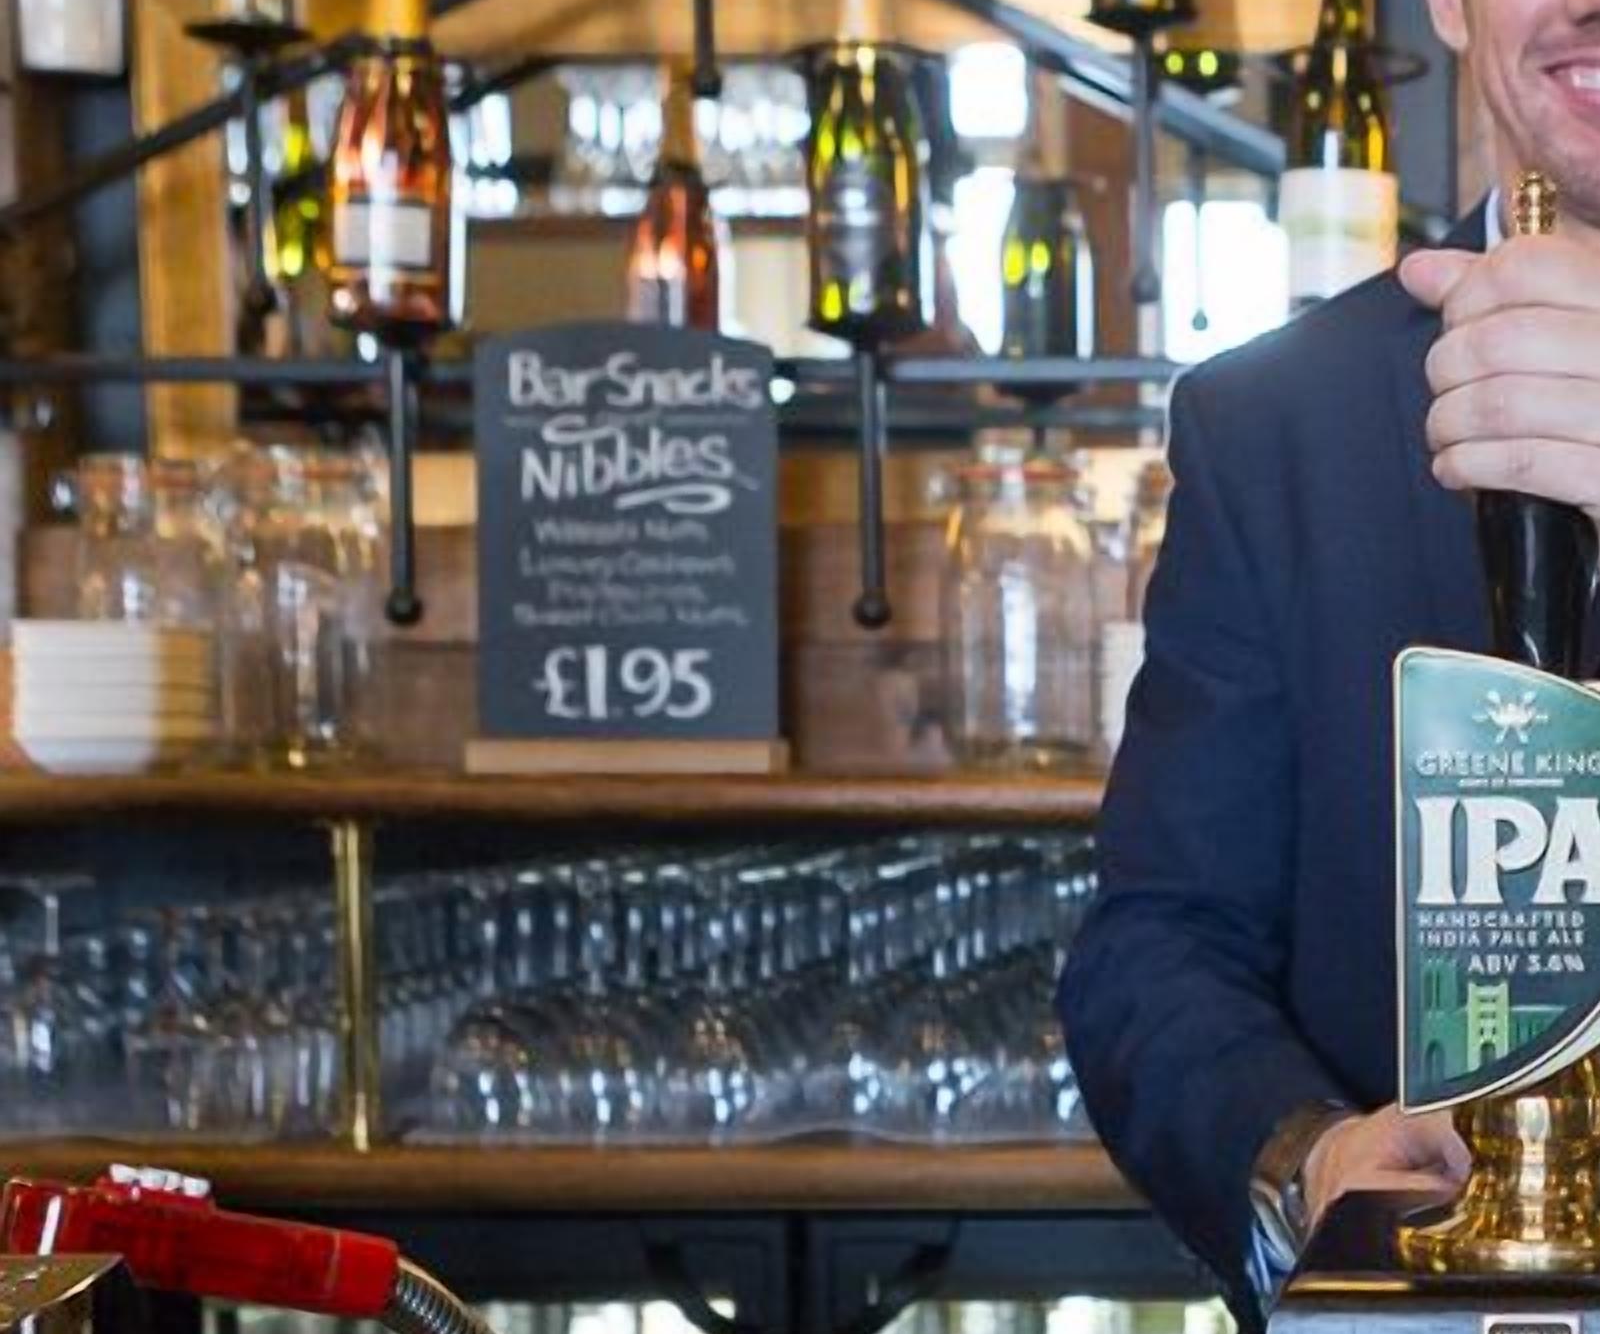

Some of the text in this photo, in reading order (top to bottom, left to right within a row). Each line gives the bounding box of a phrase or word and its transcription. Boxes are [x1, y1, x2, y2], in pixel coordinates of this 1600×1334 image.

[508, 350, 764, 409] Bar Snacks
[521, 419, 736, 501] Nibbles
[1416, 750, 1525, 776] GREENE
[1419, 910, 1585, 928] HANDCRAFTED
[1419, 929, 1585, 948] INDIA PALE ALE
[1467, 954, 1519, 974] ABV
